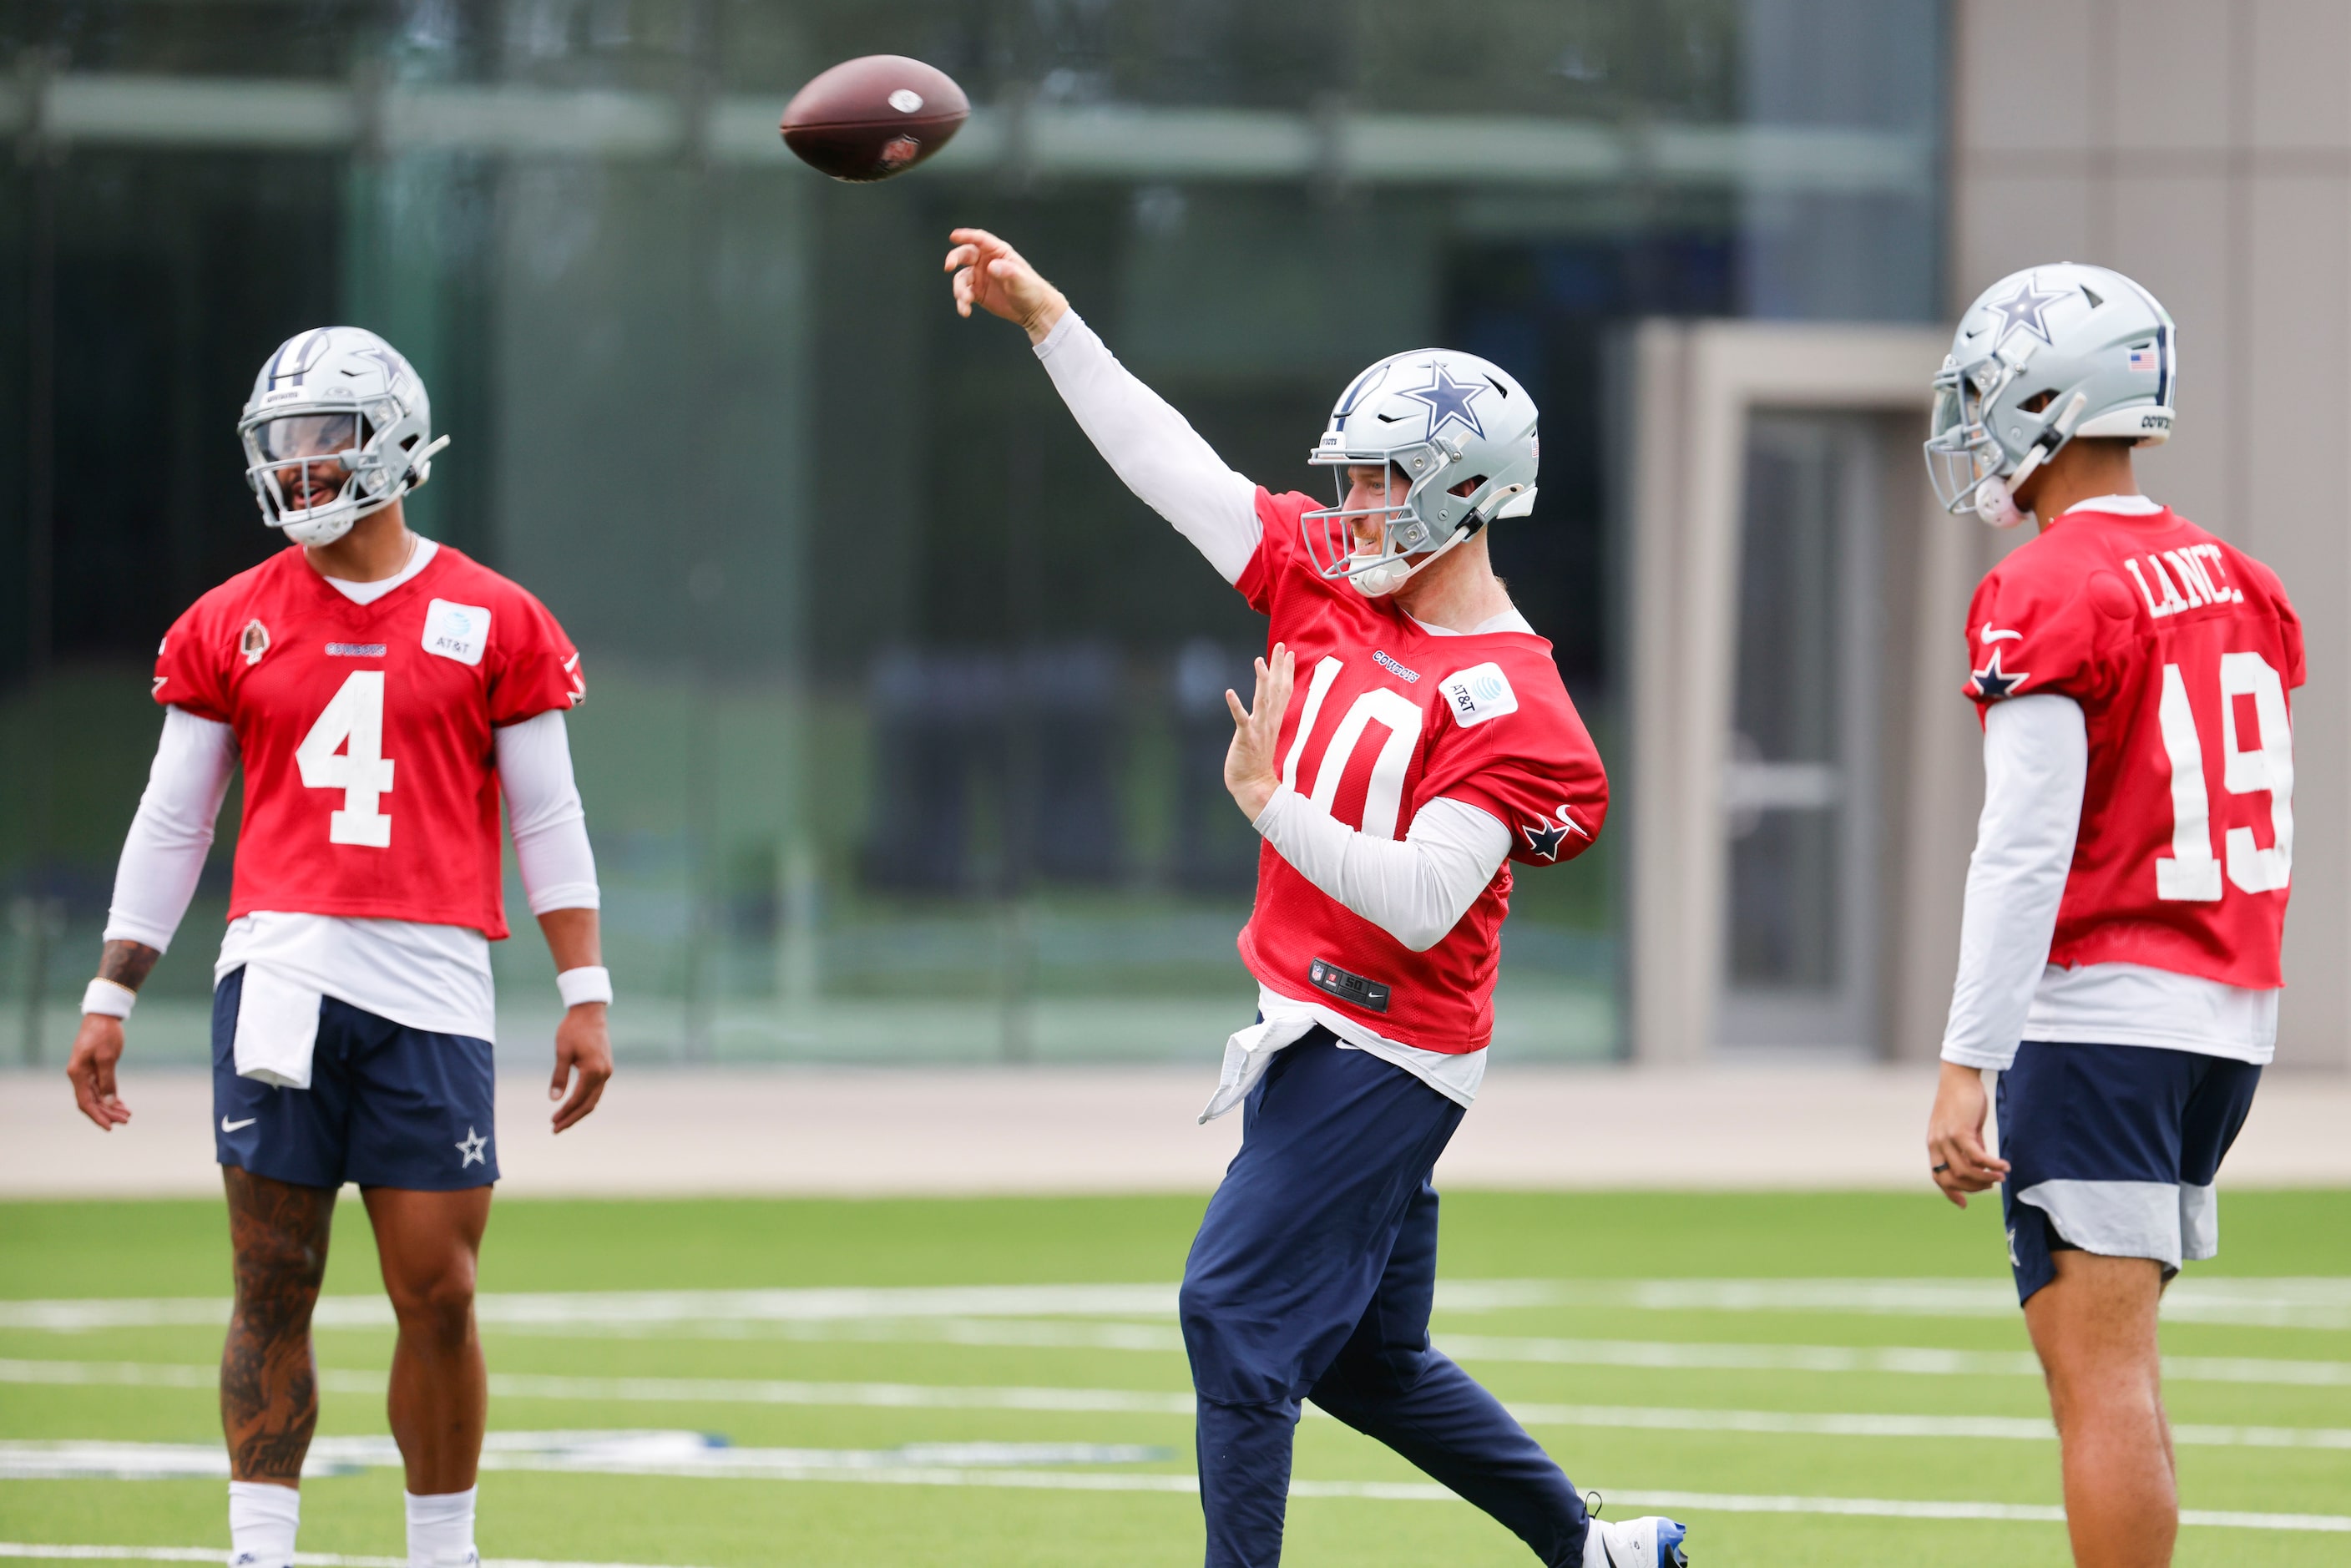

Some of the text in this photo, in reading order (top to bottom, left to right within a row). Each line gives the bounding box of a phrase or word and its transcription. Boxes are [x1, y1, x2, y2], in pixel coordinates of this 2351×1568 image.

[436, 636, 470, 655] AT&T
[1373, 650, 1421, 683] COWBOYS
[1449, 684, 1476, 712] AT&T
[296, 670, 395, 848] 4
[1282, 655, 1423, 839] 10
[2156, 652, 2294, 902] 19
[1345, 976, 1363, 991] 50
